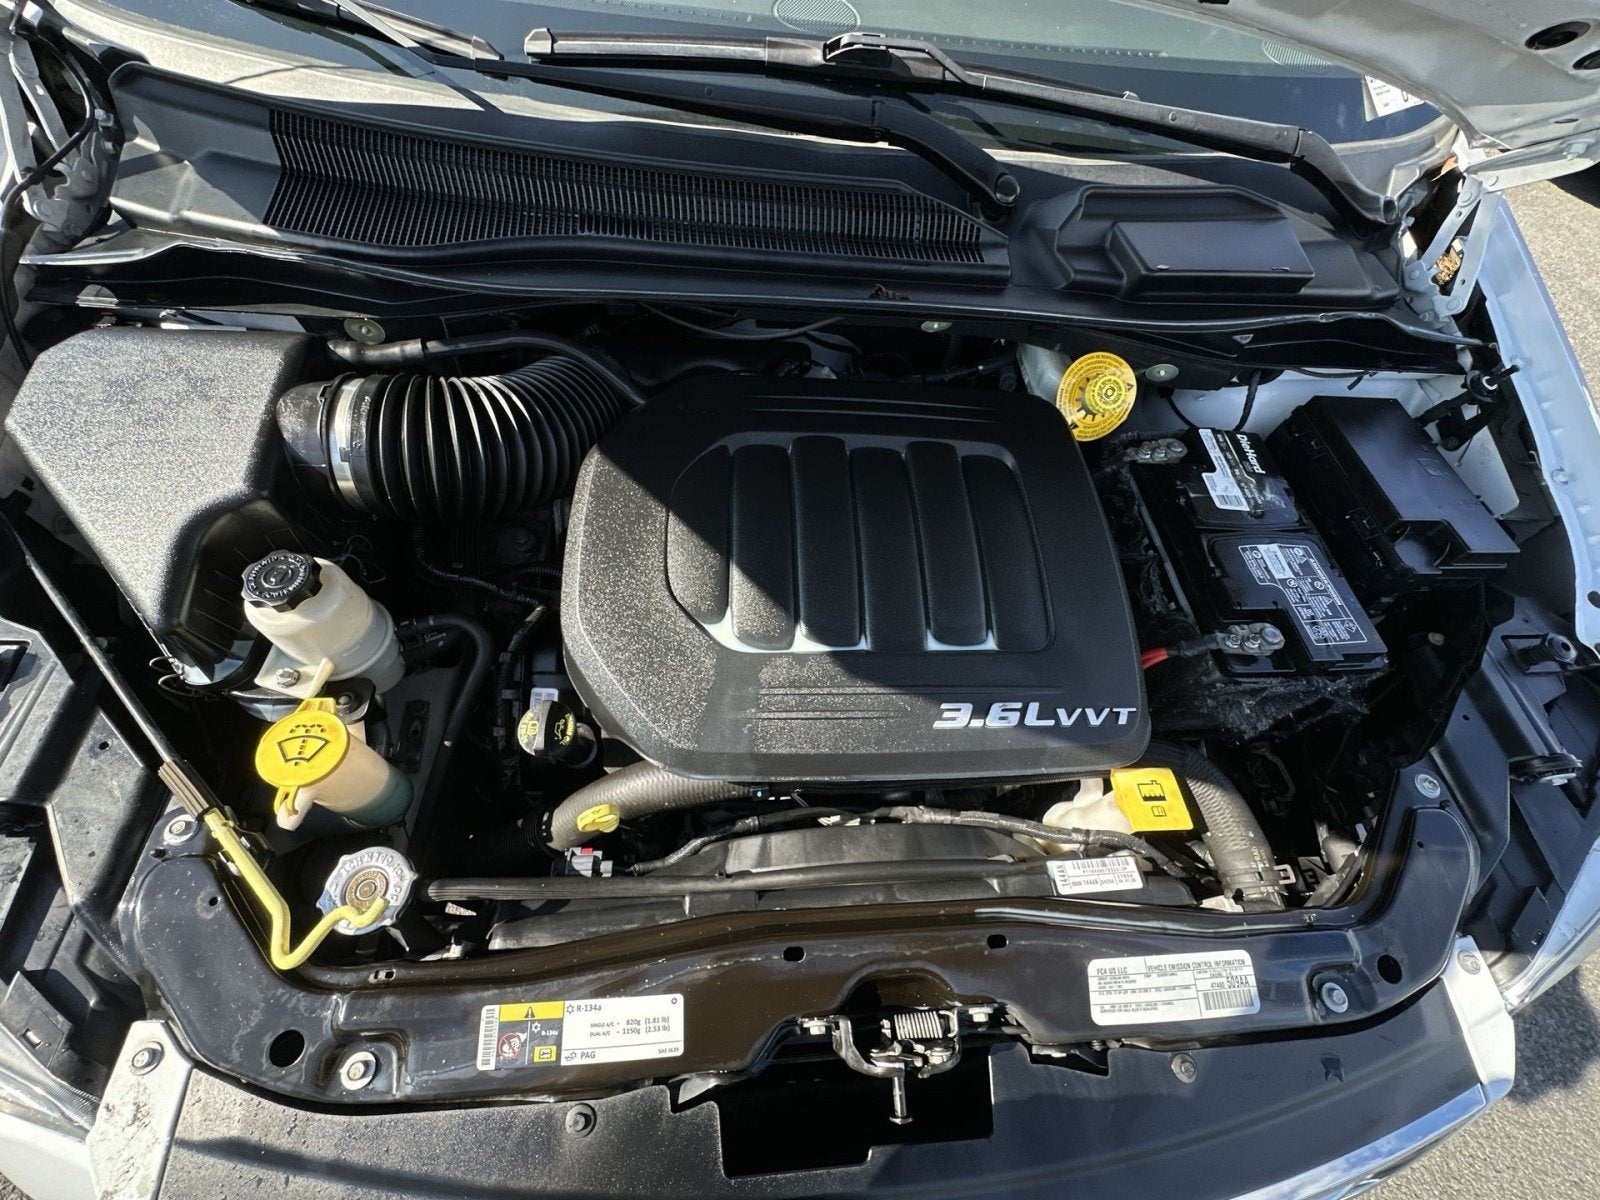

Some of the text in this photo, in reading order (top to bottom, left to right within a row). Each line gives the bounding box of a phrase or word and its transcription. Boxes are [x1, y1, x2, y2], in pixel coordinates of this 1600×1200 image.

[1236, 434, 1266, 474] DieHard
[1109, 967, 1117, 975] US
[1117, 966, 1128, 974] LLC
[1148, 959, 1245, 972] VEHICLE EMISSION CONTROL INFORMATION
[1226, 975, 1250, 989] 509AA
[576, 1004, 602, 1013] R-134a
[626, 1019, 641, 1027] 820g
[644, 1017, 660, 1025] (1.81
[661, 1016, 670, 1024] lb)
[622, 1027, 641, 1035] 1150g
[645, 1026, 661, 1034] (2.53
[661, 1024, 670, 1032] lb)
[580, 1051, 596, 1059] PAG
